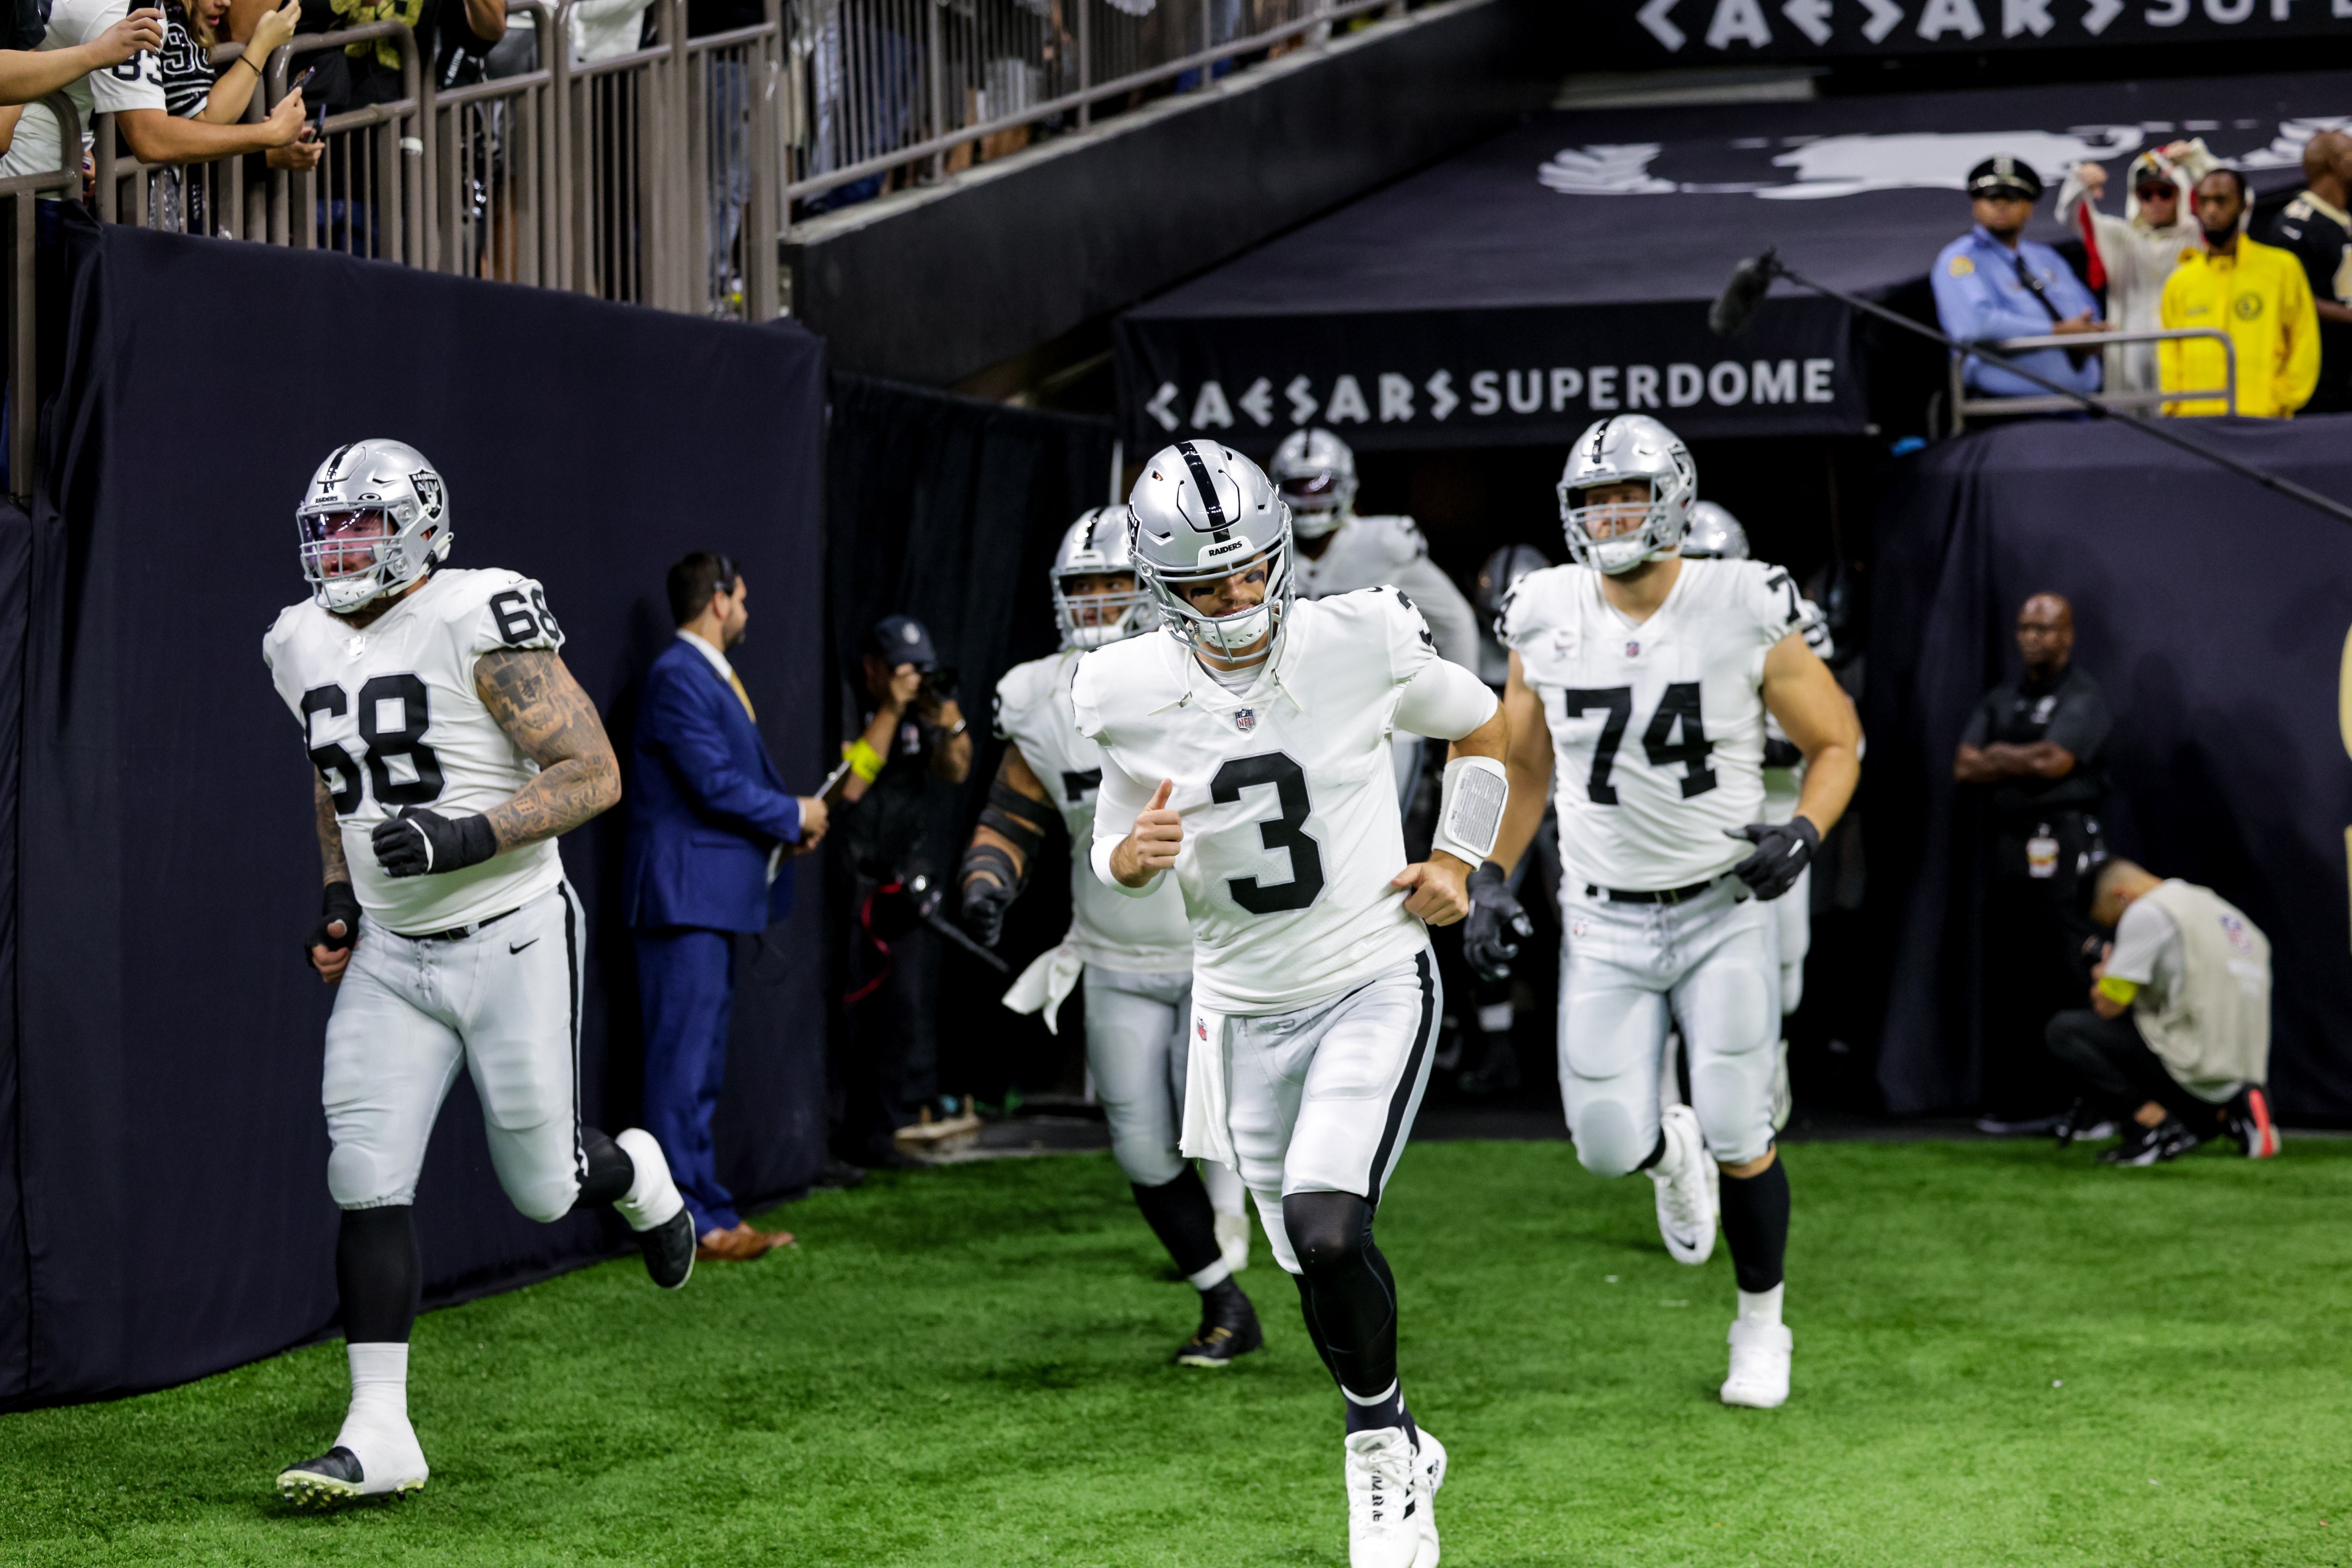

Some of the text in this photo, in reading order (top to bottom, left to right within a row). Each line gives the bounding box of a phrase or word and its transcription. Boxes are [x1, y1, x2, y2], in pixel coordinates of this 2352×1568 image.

[1145, 358, 1835, 432] CAESARS SUPERDOME
[1209, 541, 1242, 557] RAIDERS
[489, 588, 560, 644] 68
[299, 671, 448, 816] 68
[1238, 717, 1253, 728] NFL
[1565, 681, 1718, 806] 74
[1208, 749, 1327, 916] 3
